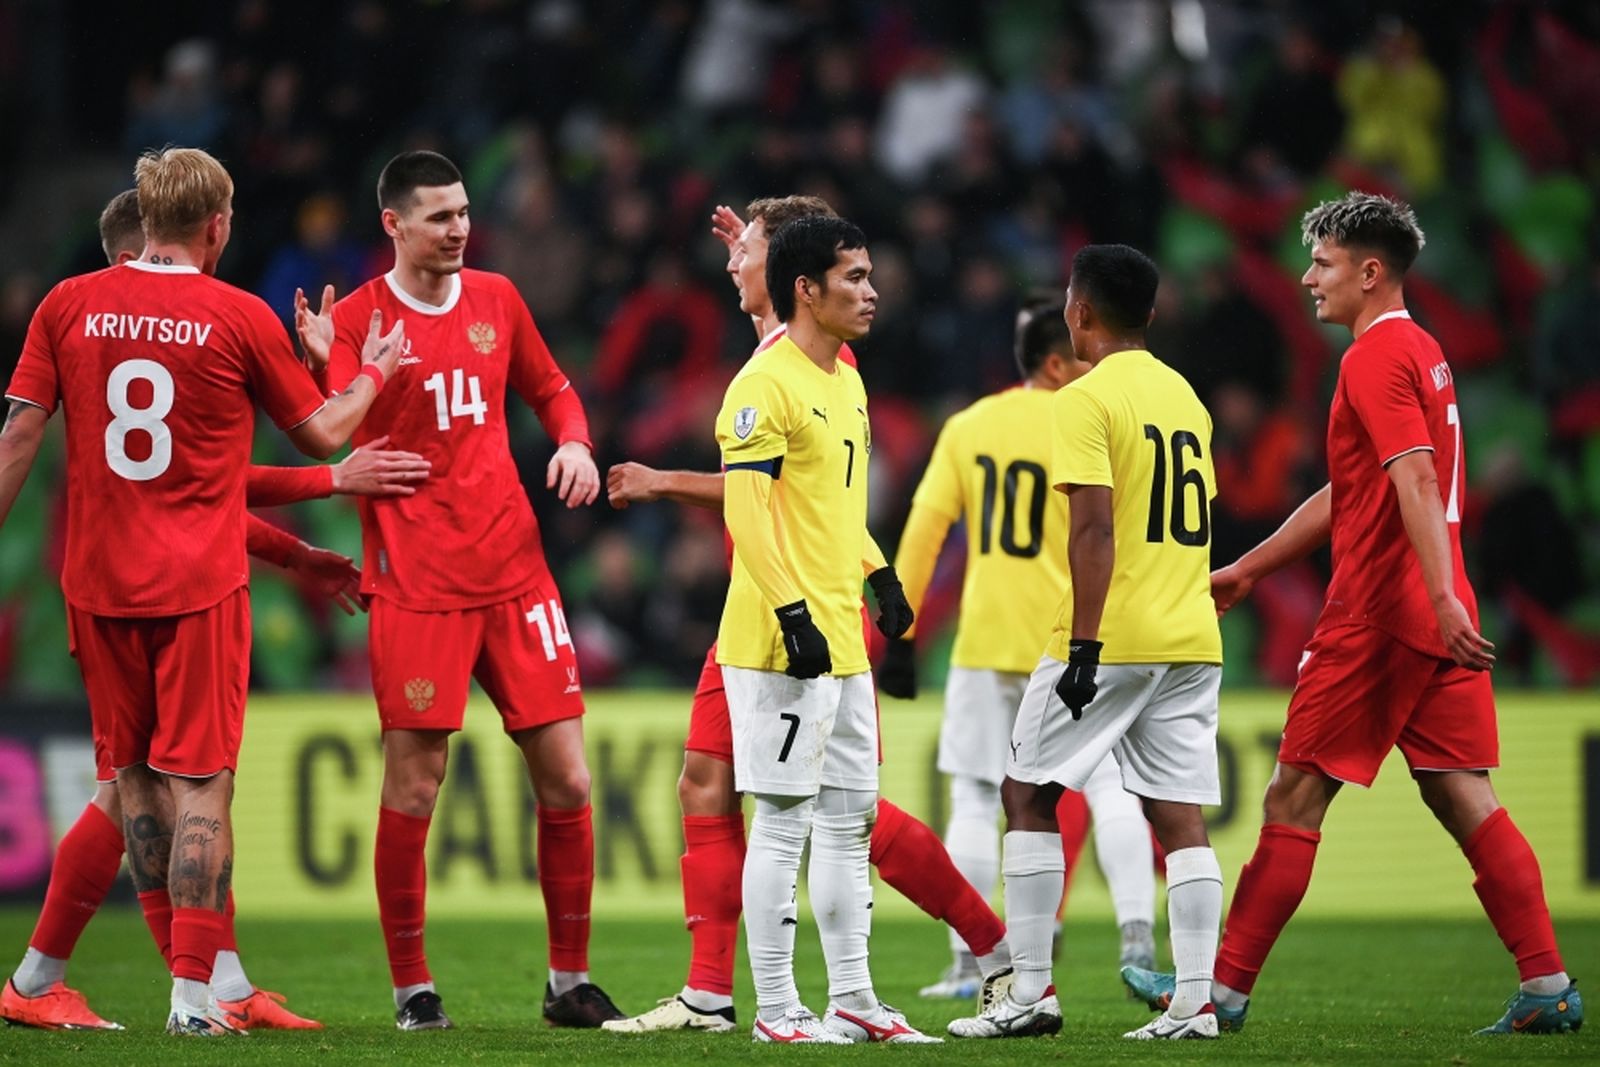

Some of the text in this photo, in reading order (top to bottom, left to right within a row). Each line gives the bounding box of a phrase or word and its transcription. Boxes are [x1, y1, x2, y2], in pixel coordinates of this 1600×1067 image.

[84, 313, 212, 348] KRIVTSOV
[104, 358, 175, 481] 8
[424, 368, 488, 431] 14
[843, 439, 854, 488] 7
[1144, 424, 1209, 547] 16
[975, 455, 1047, 559] 10
[525, 599, 576, 662] 14
[777, 712, 801, 763] 7
